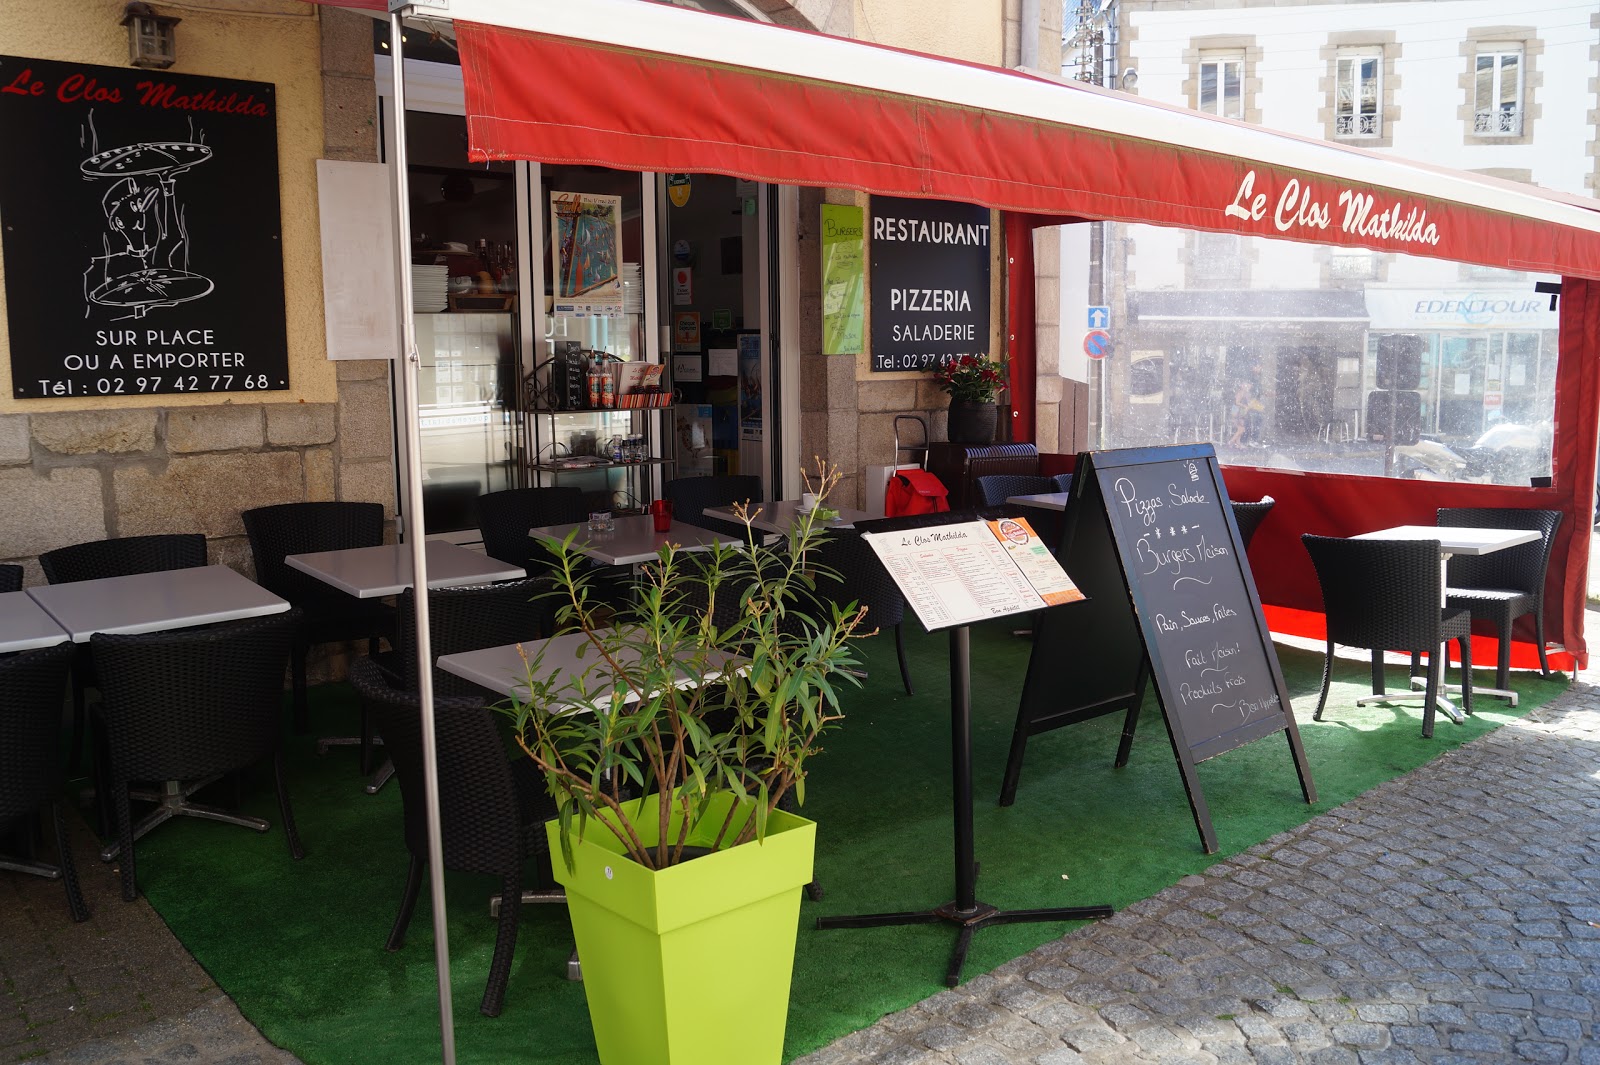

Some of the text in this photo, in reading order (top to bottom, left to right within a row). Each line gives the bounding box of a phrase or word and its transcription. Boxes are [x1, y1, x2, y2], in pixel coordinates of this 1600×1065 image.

[2, 69, 269, 118] Le Clos Mathilda
[1225, 170, 1440, 245] Le Clos Mathilda
[873, 216, 990, 247] RESTAURANT
[890, 288, 972, 312] PIZZERIA
[95, 329, 215, 346] SUR PLACE
[892, 324, 975, 342] SALADERIE
[64, 352, 245, 370] OU A EMPORTER
[877, 354, 894, 369] Tel
[902, 354, 918, 368] 02
[921, 354, 936, 368] 97
[38, 379, 73, 396] Tél
[97, 377, 125, 394] 02
[135, 376, 162, 393] 97
[173, 375, 199, 391] 42
[208, 374, 234, 390] 77
[244, 373, 270, 389] 68
[1136, 534, 1229, 575] Burgers Maison
[1212, 603, 1238, 622] Frites
[1184, 649, 1208, 669] Fait
[1179, 671, 1247, 706] Produits Frais
